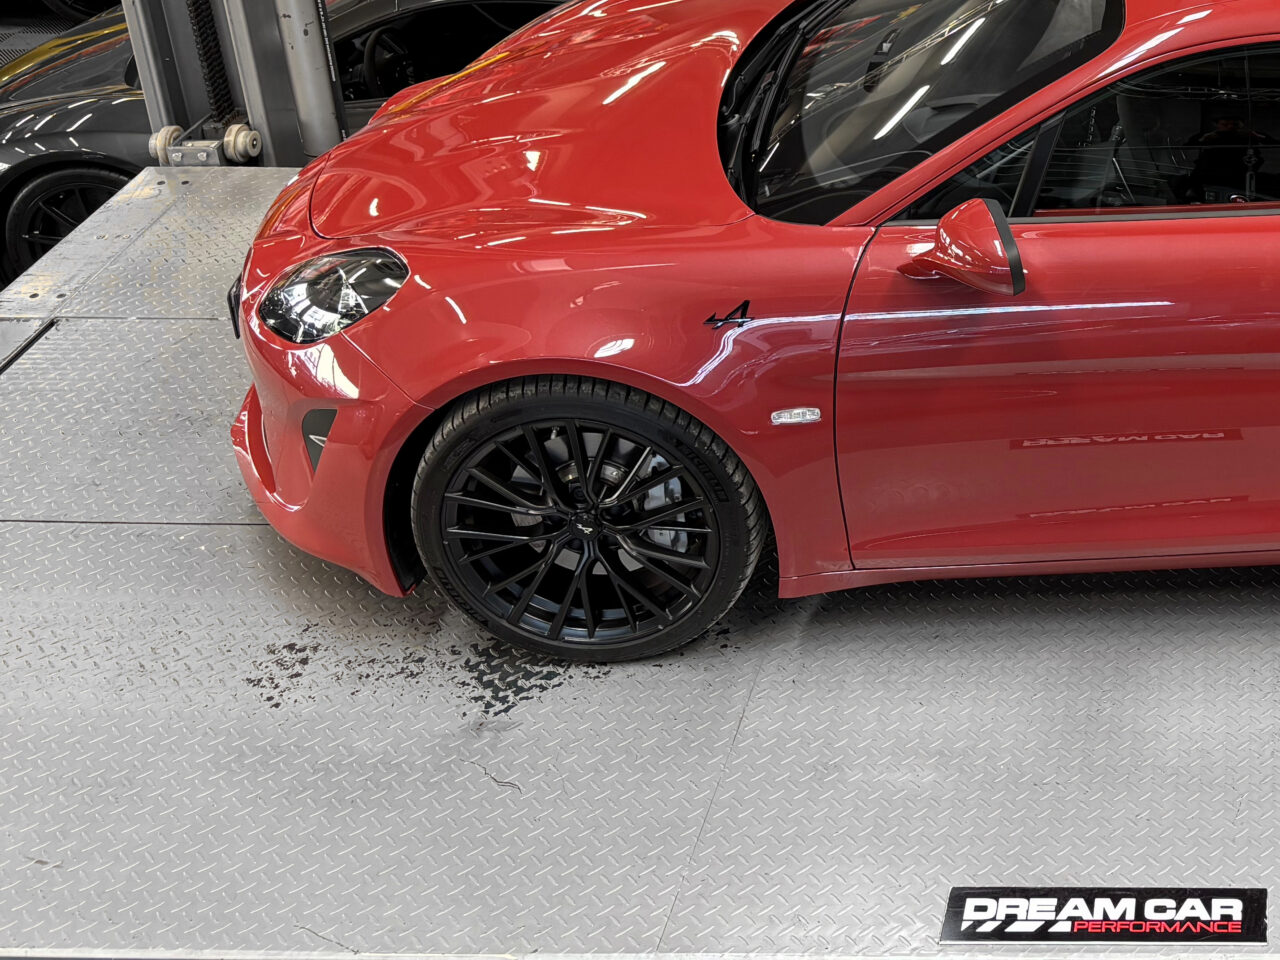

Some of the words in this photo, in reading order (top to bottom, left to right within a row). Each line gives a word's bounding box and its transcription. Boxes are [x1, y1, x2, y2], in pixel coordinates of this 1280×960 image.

[963, 898, 1136, 920] DREAM
[1144, 898, 1243, 920] CAR
[1073, 921, 1242, 933] PERFORMANCE
